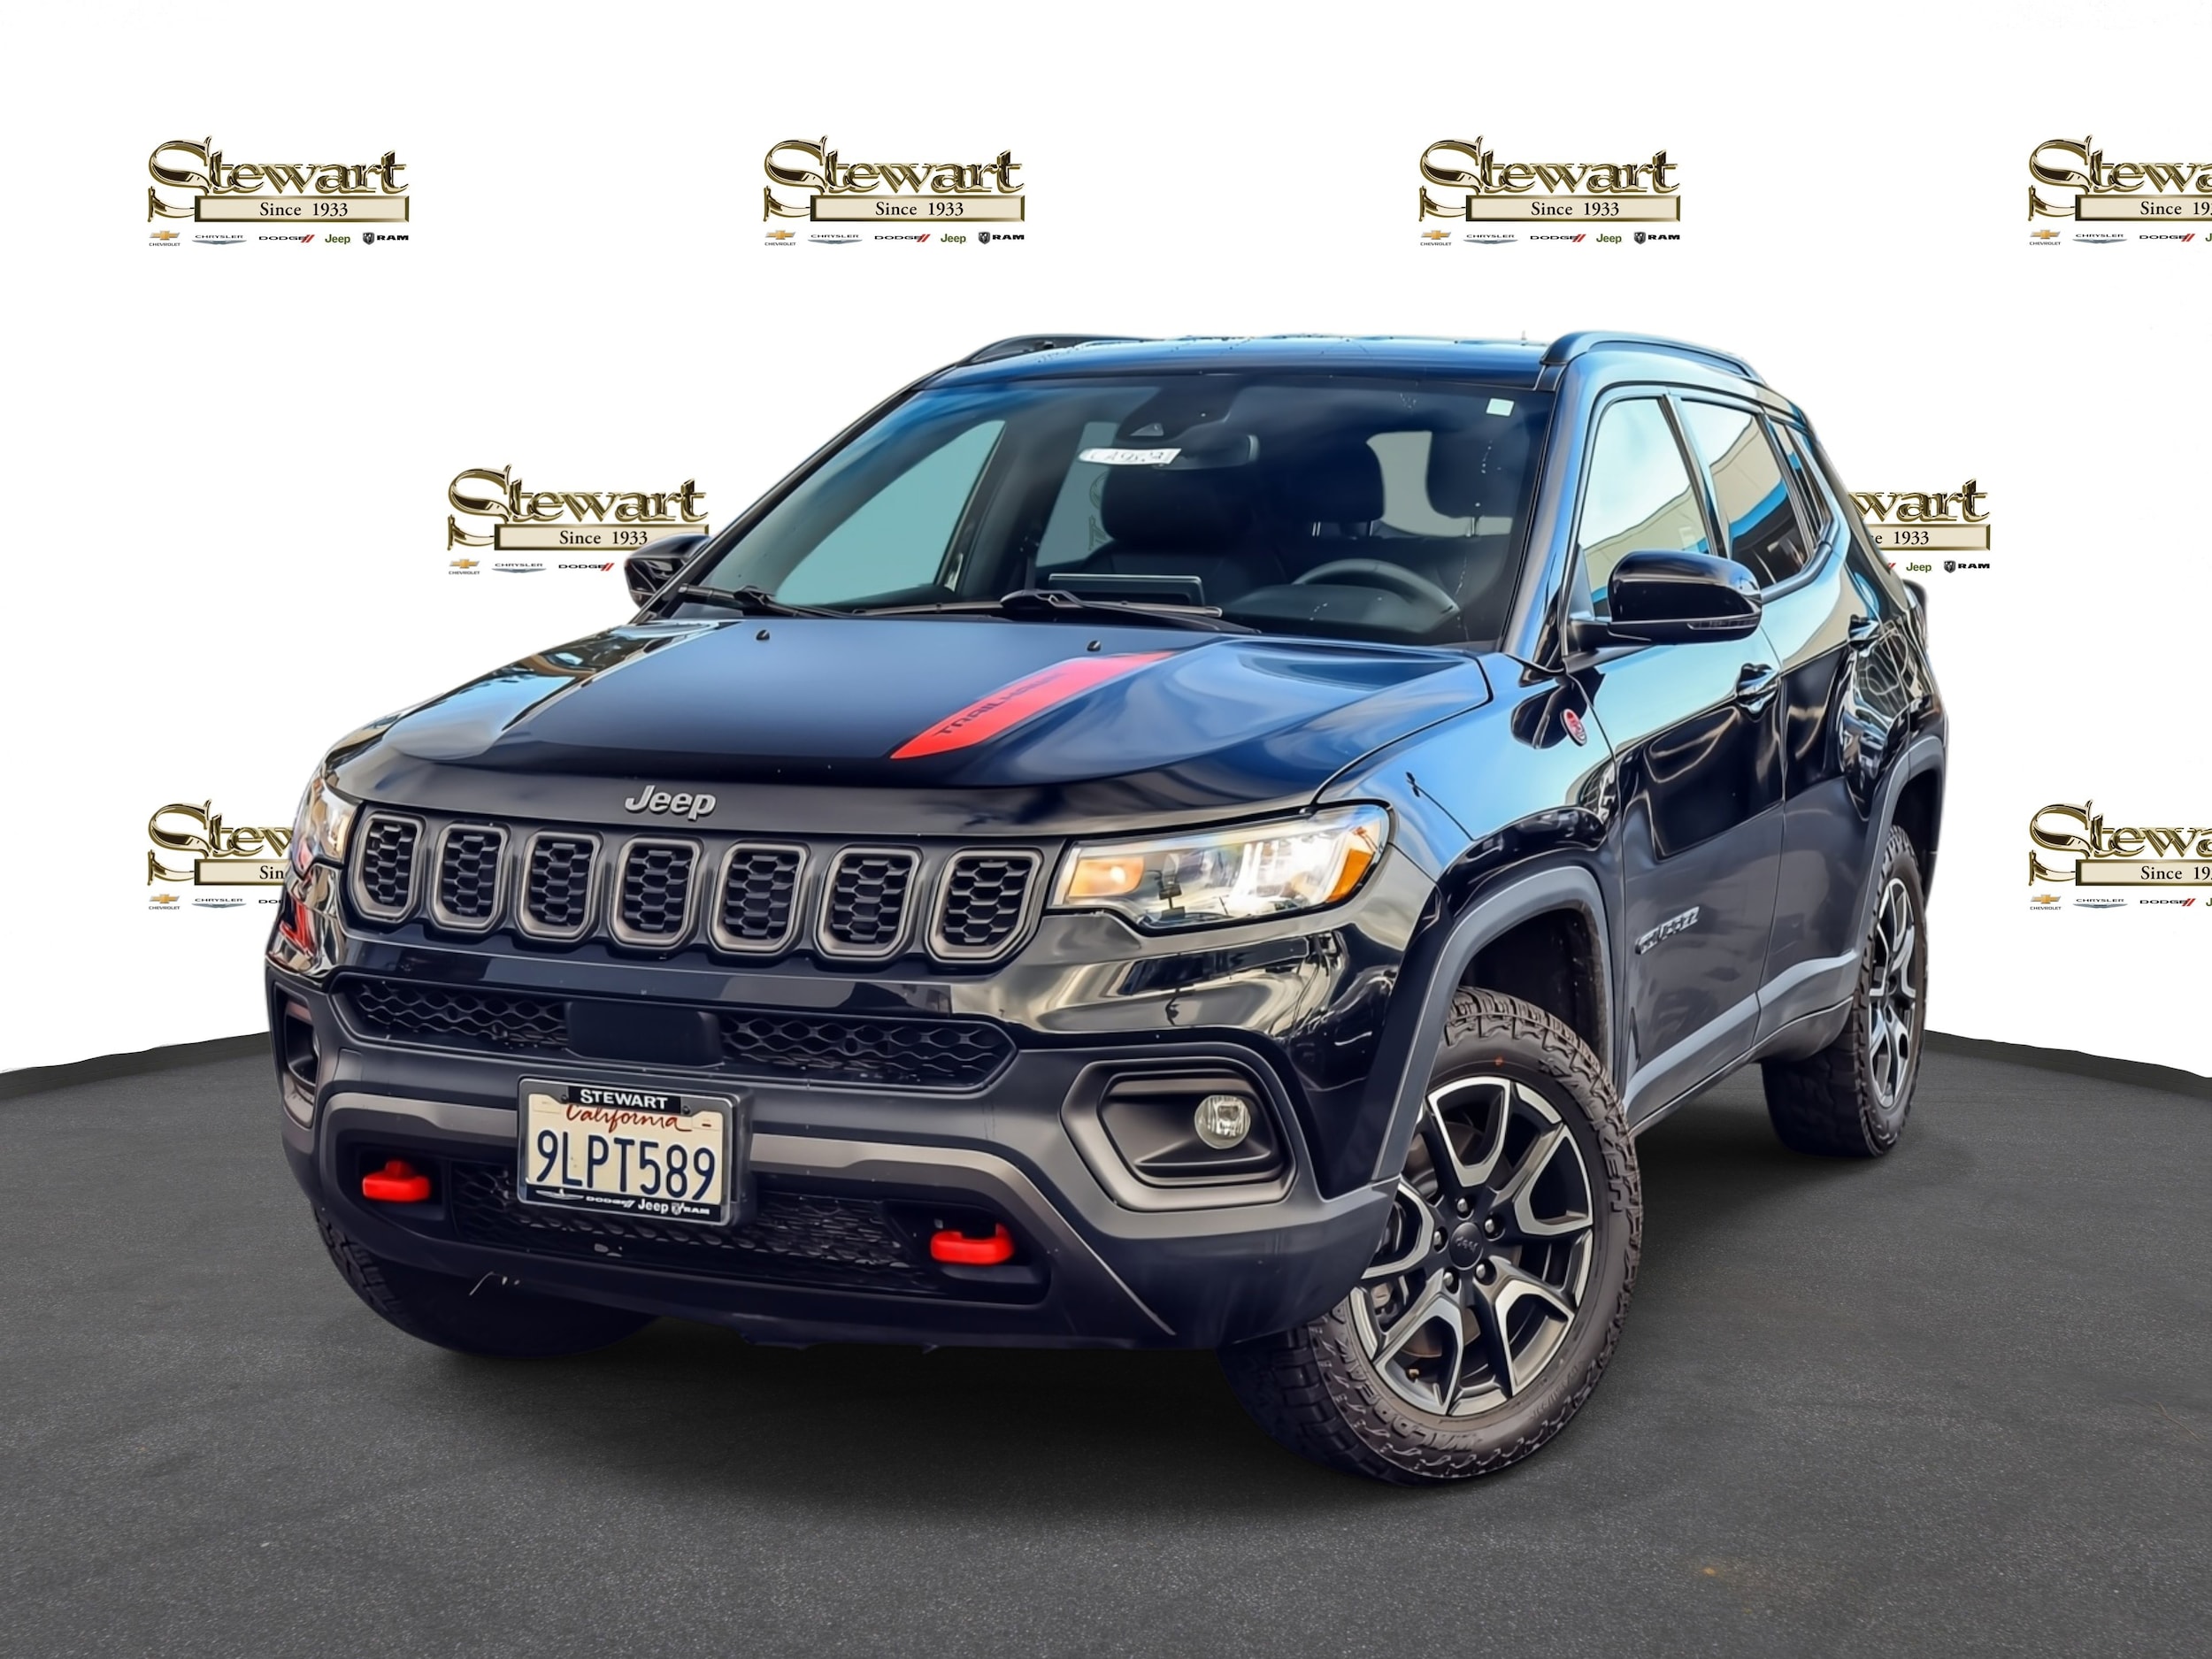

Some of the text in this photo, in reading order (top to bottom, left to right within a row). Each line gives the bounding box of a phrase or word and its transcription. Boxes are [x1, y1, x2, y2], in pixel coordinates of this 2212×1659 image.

[148, 134, 409, 222] Stewart
[764, 134, 1025, 221] Stewart
[1419, 134, 1680, 221] Stewart
[259, 202, 349, 217] Since 1933
[875, 201, 964, 216] Since 1933
[1531, 201, 1620, 216] Since 1933
[2139, 201, 2212, 216] Since 19
[325, 234, 350, 244] Jeep
[941, 233, 966, 243] Jeep
[1596, 233, 1622, 243] Jeep
[448, 463, 709, 550] Stewart
[559, 530, 649, 545] Since 1933
[1893, 531, 1929, 545] 1933
[1906, 562, 1932, 573] Jeep
[625, 785, 717, 821] Jeep
[2140, 865, 2212, 880] Since 19
[580, 1088, 668, 1110] STEWART
[565, 1104, 693, 1133] California
[536, 1129, 716, 1201] 9LPT589
[638, 1199, 669, 1214] Jeep
